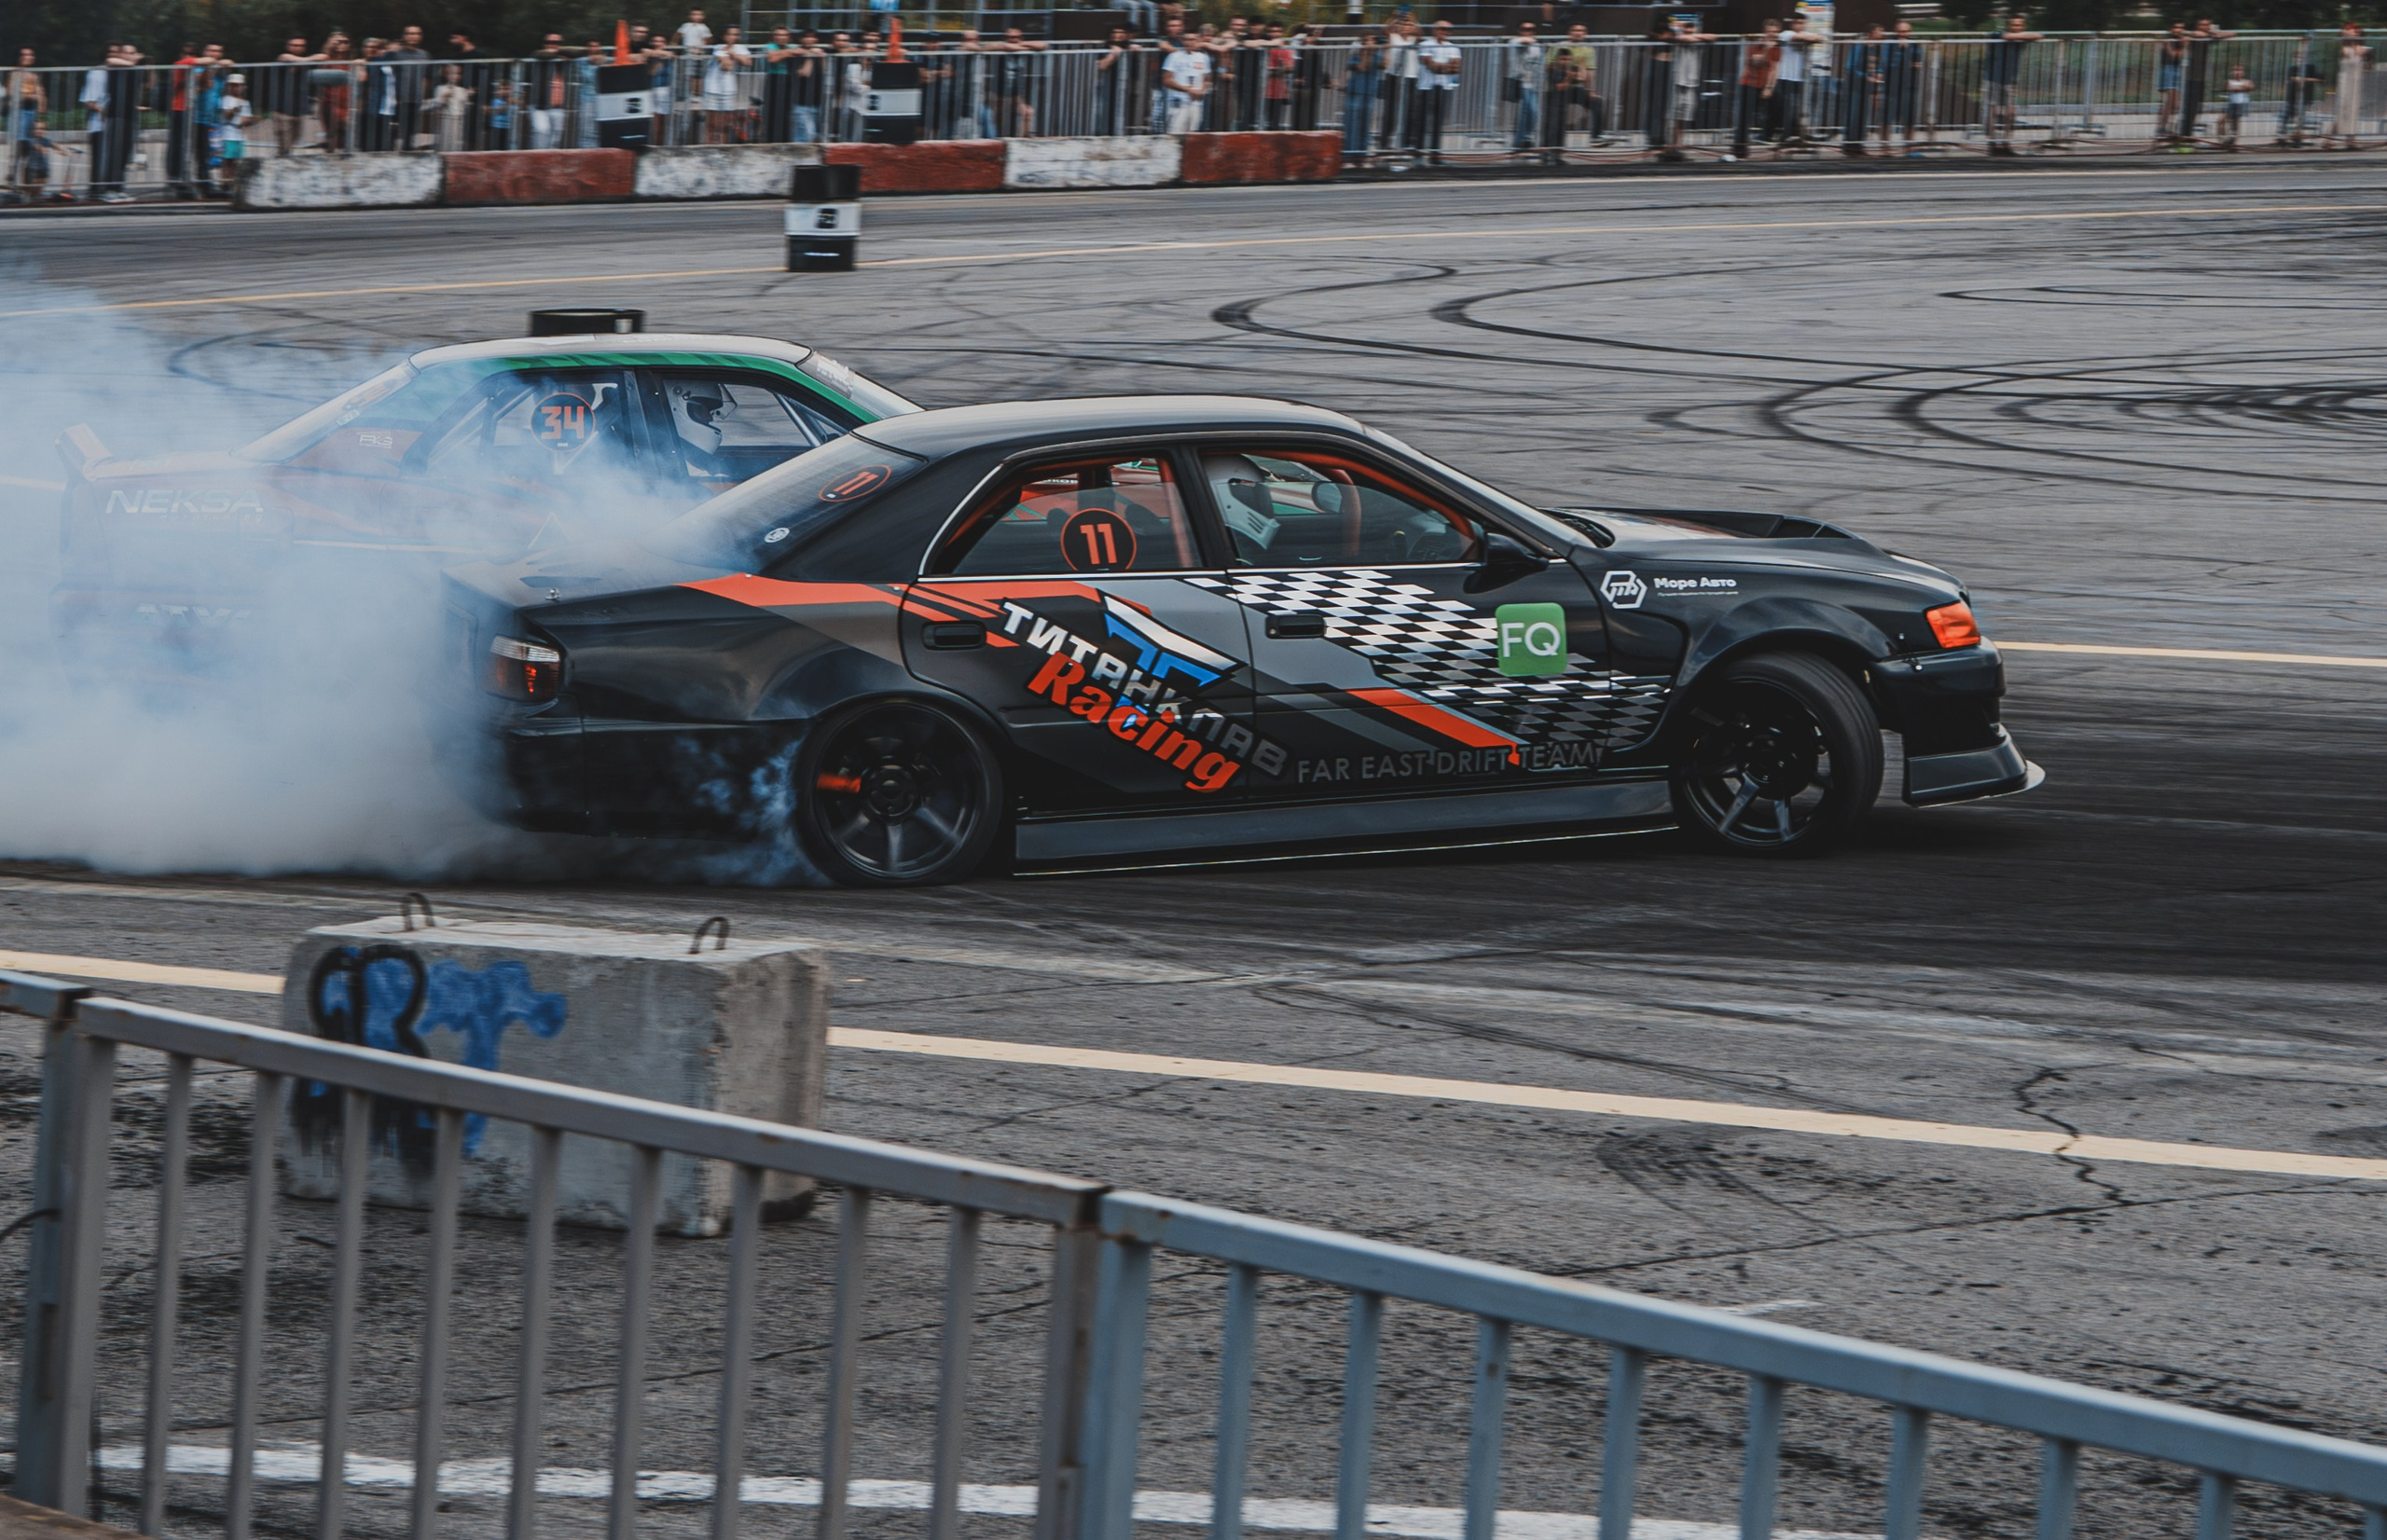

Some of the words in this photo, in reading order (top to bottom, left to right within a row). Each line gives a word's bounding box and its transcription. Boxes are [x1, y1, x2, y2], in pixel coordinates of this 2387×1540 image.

[540, 406, 585, 440] 34
[833, 471, 879, 495] 11
[104, 488, 264, 514] NEKSA
[1080, 524, 1118, 565] 11
[1653, 577, 1698, 590] Море
[1699, 576, 1737, 587] Авто
[1501, 622, 1561, 657] FQ
[1027, 651, 1241, 793] Racing
[1298, 757, 1351, 784] FAR
[1361, 752, 1427, 779] EAST
[1437, 748, 1511, 776] DRIFT
